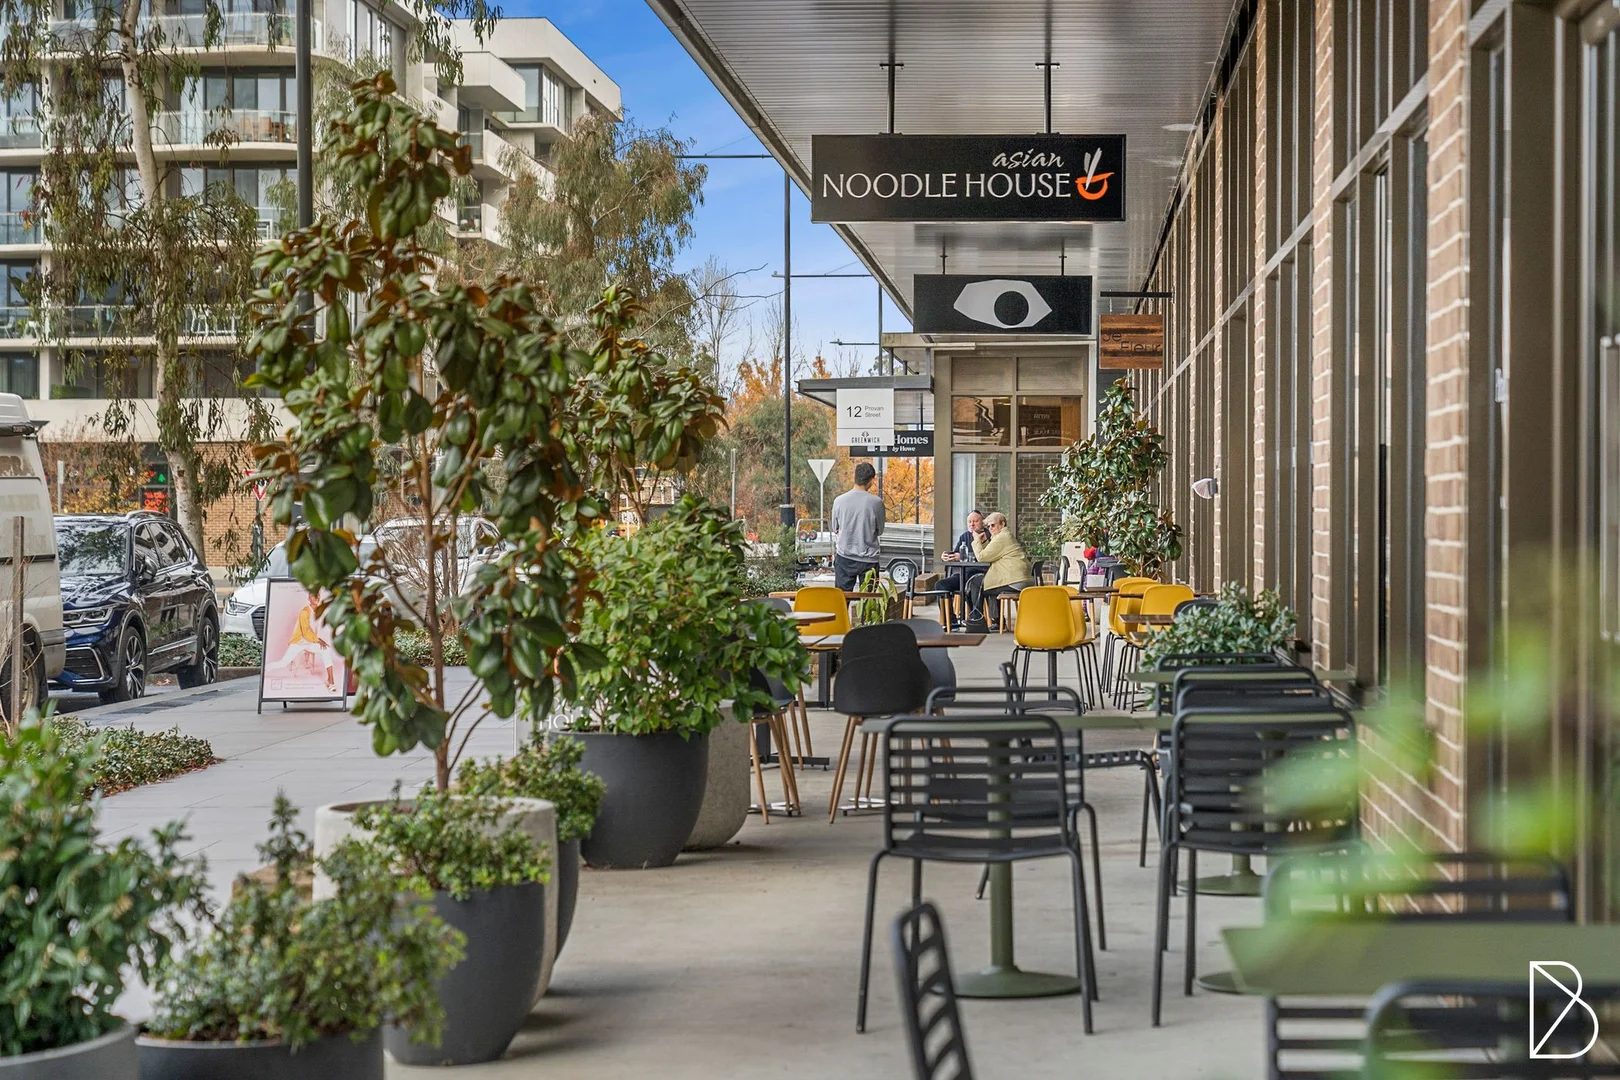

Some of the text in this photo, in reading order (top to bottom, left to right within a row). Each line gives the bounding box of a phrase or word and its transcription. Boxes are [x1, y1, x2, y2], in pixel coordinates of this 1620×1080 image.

[992, 148, 1064, 169] asian
[822, 172, 1071, 198] NOODLE HOUSE
[846, 405, 862, 418] 12
[851, 436, 880, 444] GREENWICH
